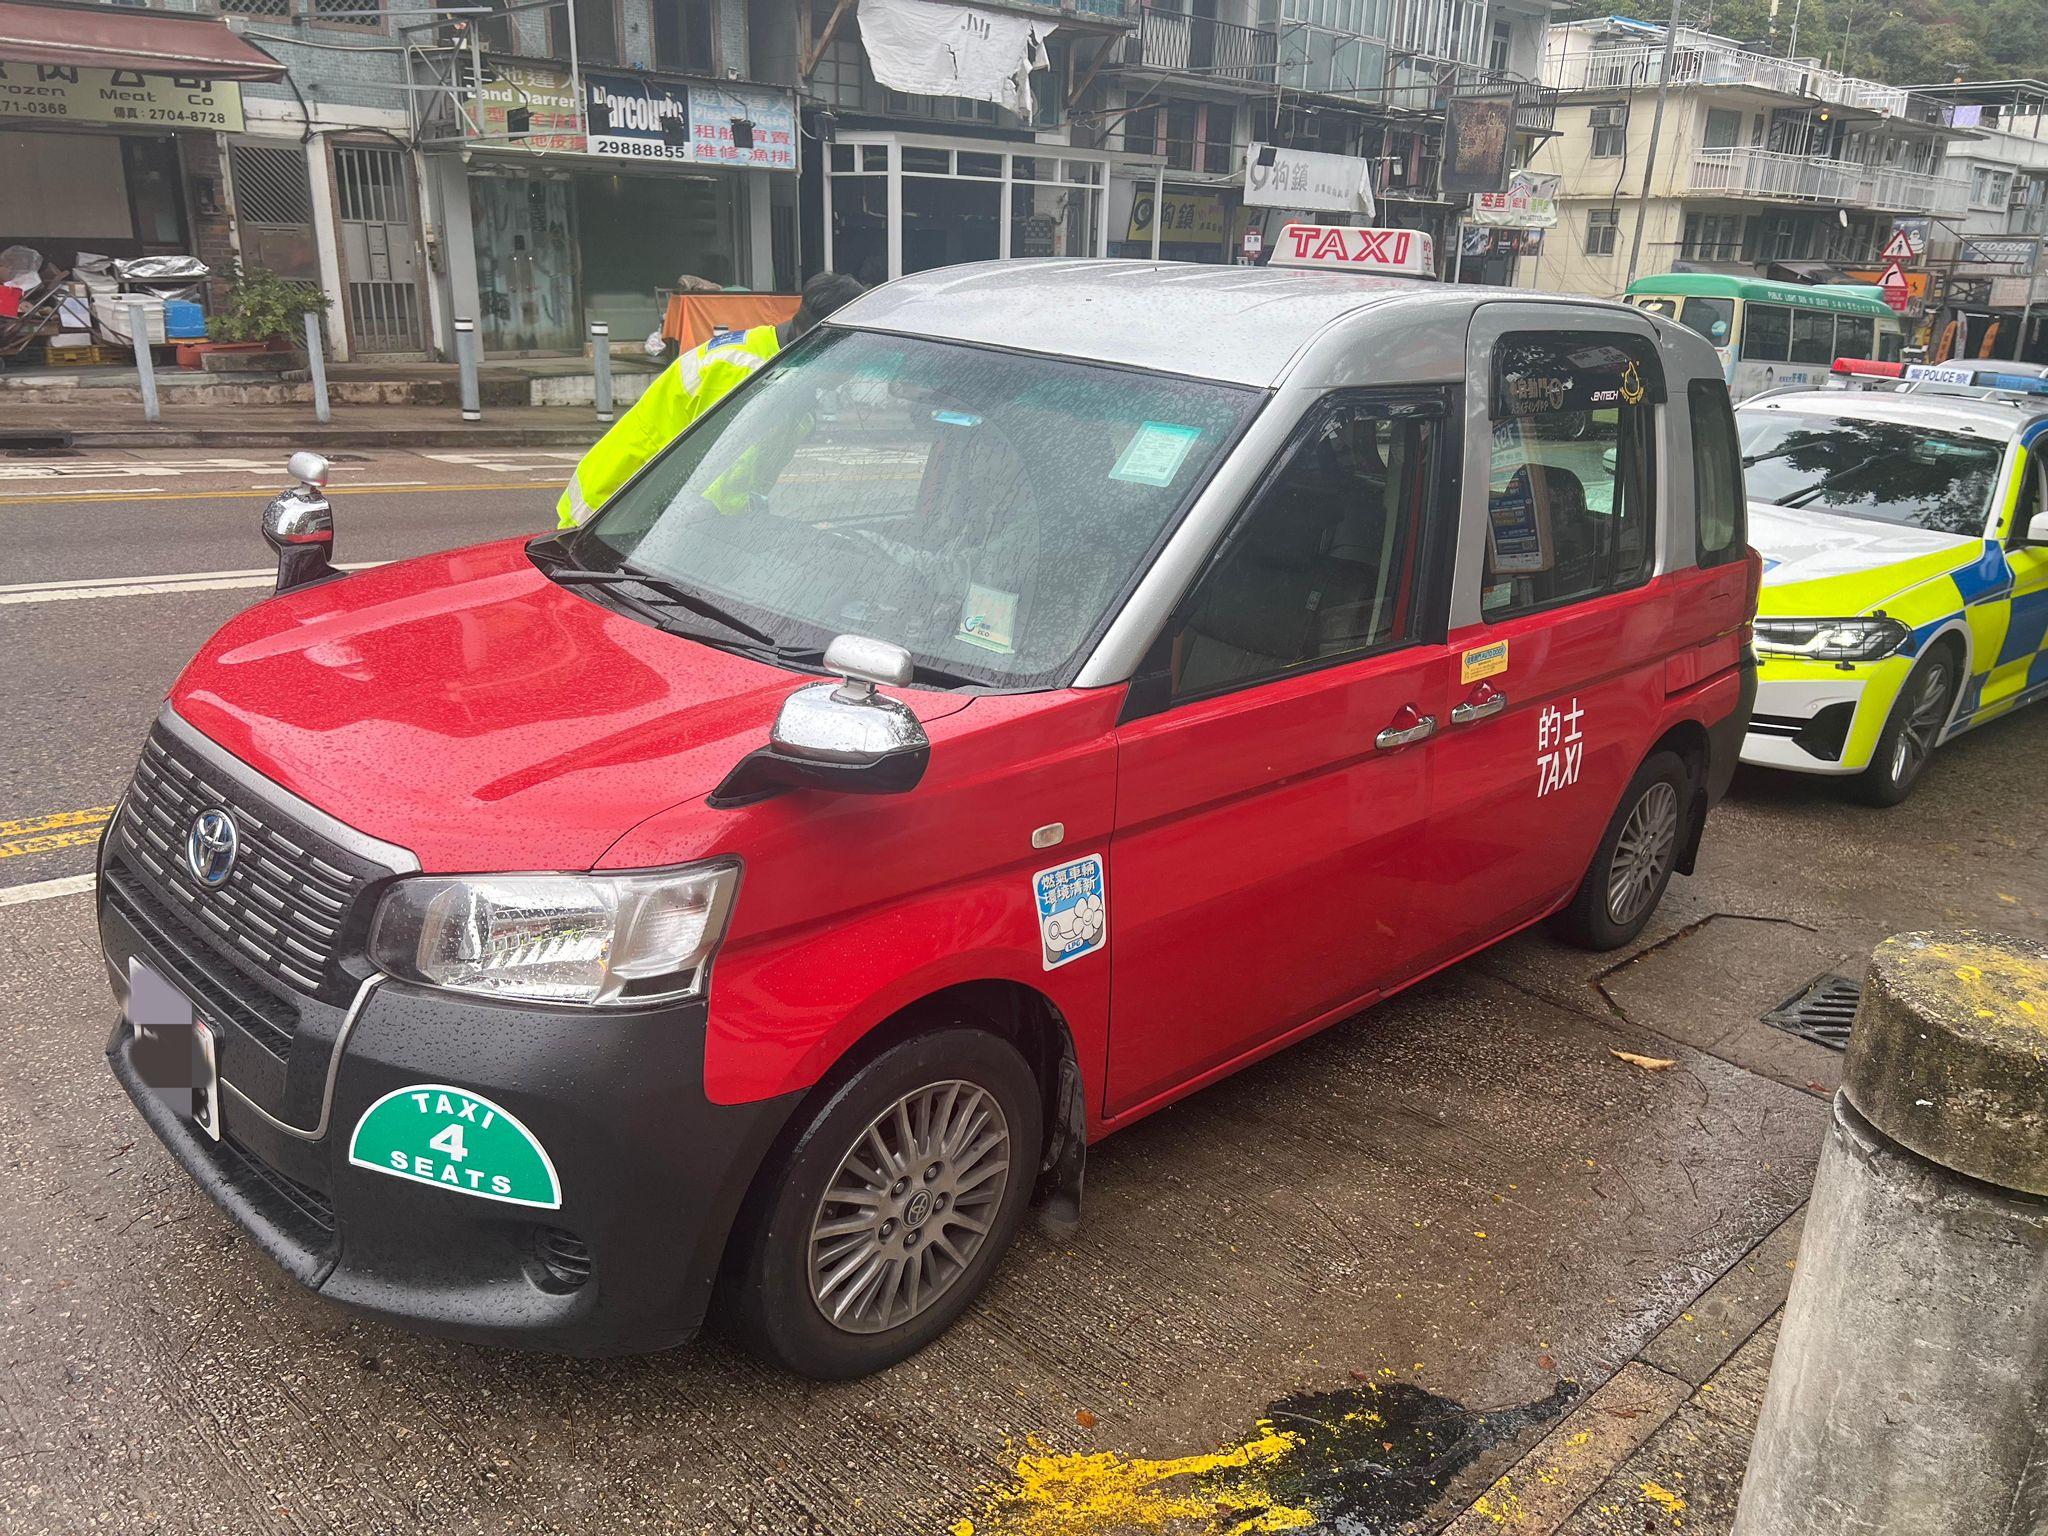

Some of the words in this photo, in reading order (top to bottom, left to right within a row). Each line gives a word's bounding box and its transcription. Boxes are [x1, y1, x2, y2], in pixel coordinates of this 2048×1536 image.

[100, 89, 157, 102] Meat
[188, 94, 214, 106] Co
[0, 100, 67, 115] 71-0368
[150, 109, 226, 124] 2704-8728
[598, 140, 685, 159] 29888855
[1289, 227, 1411, 264] TAXI
[1969, 242, 2032, 252] FEDERAL
[1923, 369, 1955, 383] POLICE
[1538, 697, 1585, 751] 的士
[1537, 742, 1583, 798] TAXI
[1066, 938, 1081, 951] LPG
[411, 1092, 495, 1129] TAXI
[429, 1123, 469, 1163] 4
[390, 1150, 512, 1195] SEATS
